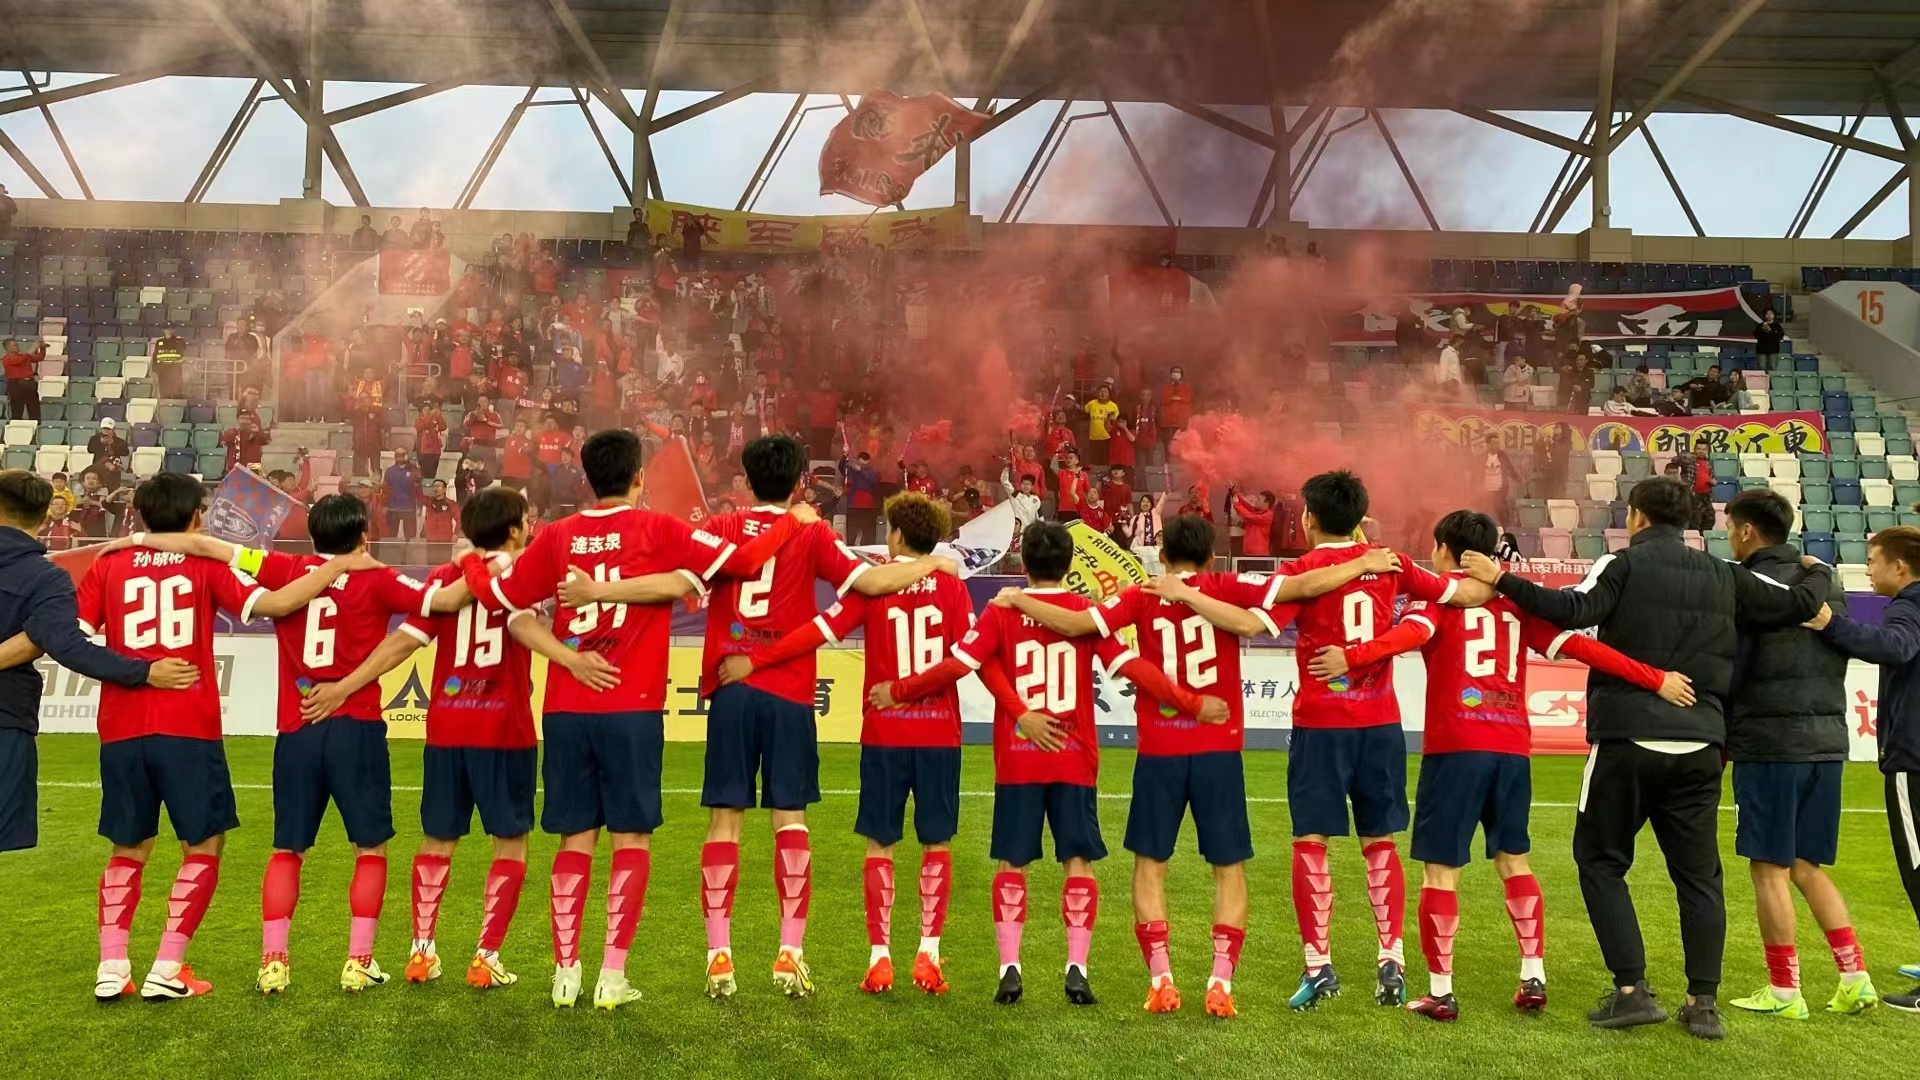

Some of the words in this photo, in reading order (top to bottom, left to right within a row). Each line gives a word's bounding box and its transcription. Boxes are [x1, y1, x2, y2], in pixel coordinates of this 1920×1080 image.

[1857, 290, 1884, 325] 15
[743, 519, 773, 537] 王
[124, 574, 194, 650] 26
[738, 555, 776, 618] 2
[1066, 570, 1091, 599] CH
[303, 596, 337, 669] 6
[454, 600, 503, 668] 15
[888, 604, 943, 679] 16
[1153, 615, 1218, 689] 12
[1343, 590, 1374, 649] 9
[1465, 607, 1521, 683] 21
[1016, 640, 1076, 714] 20
[1249, 710, 1288, 718] SELECTION
